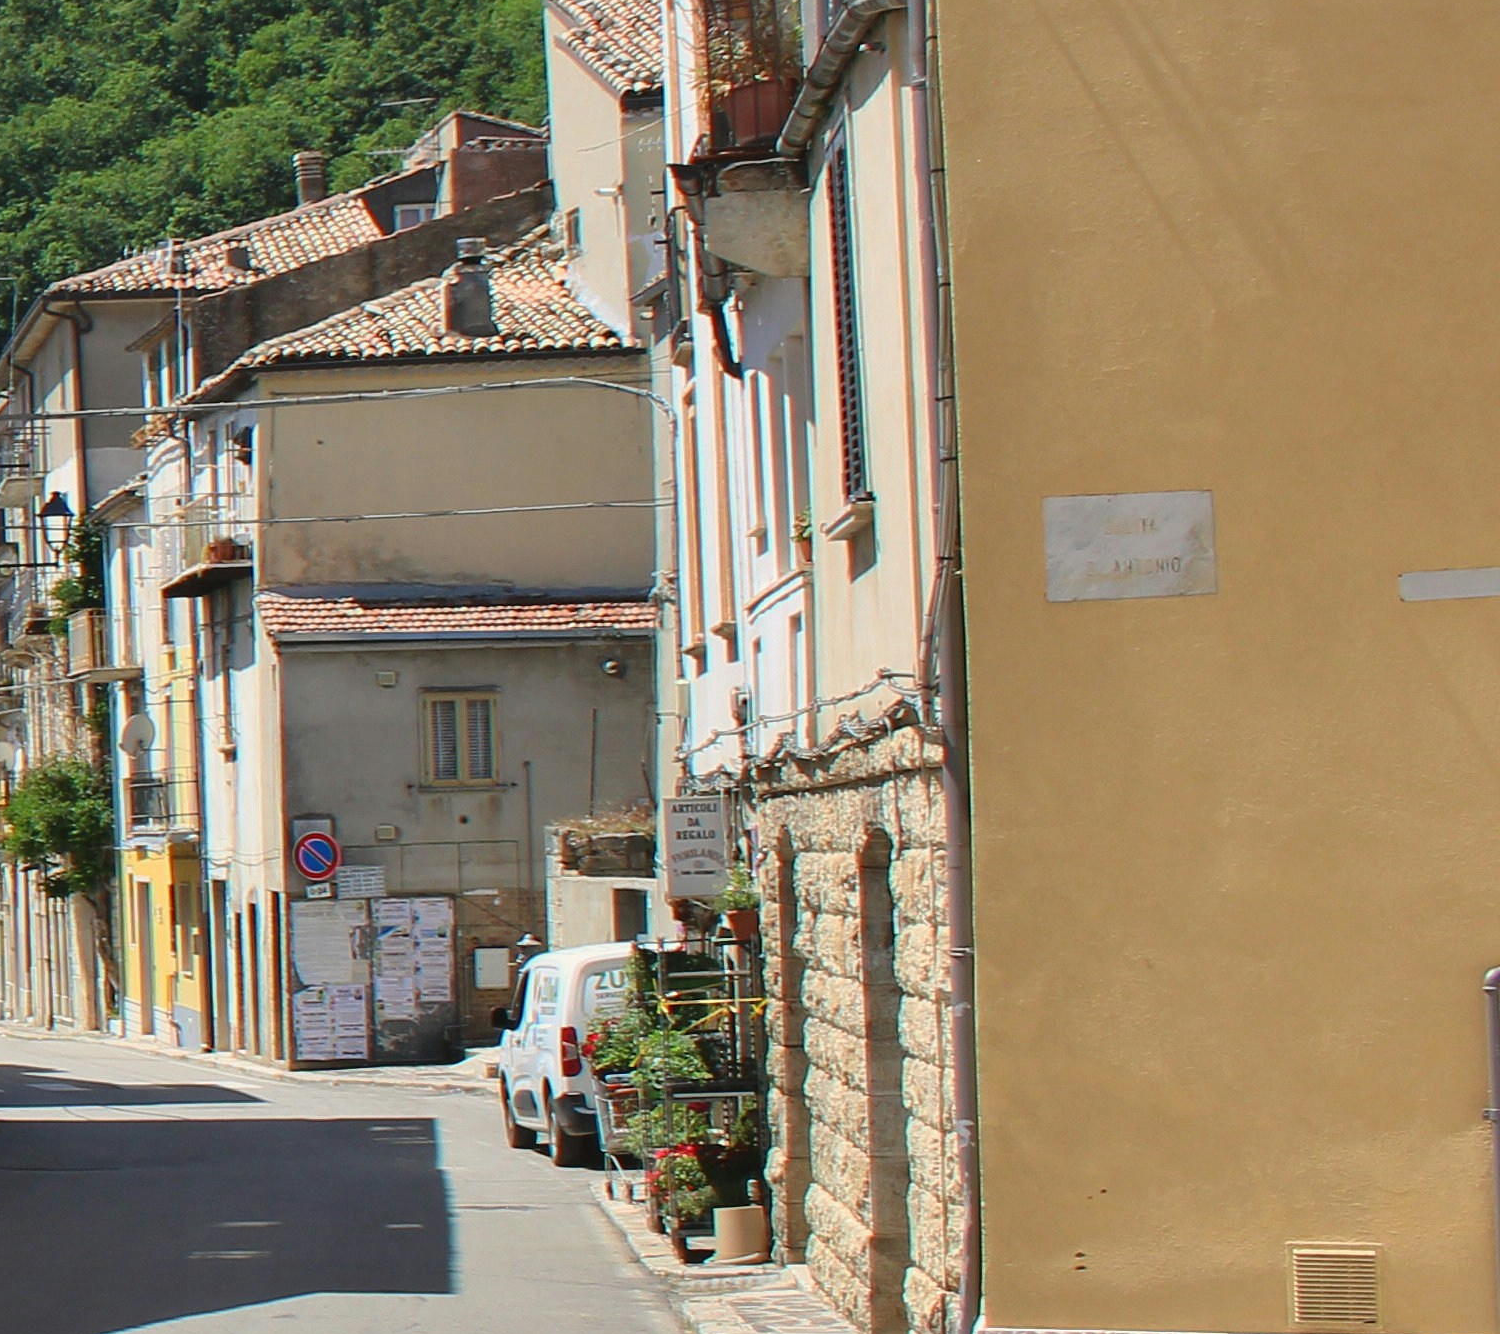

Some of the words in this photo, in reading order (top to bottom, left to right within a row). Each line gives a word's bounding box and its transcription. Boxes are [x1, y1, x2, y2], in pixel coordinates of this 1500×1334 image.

[1114, 556, 1182, 575] ANNIO
[671, 803, 717, 813] ARTICOLI
[687, 817, 700, 827] DA
[675, 829, 716, 840] REGALO
